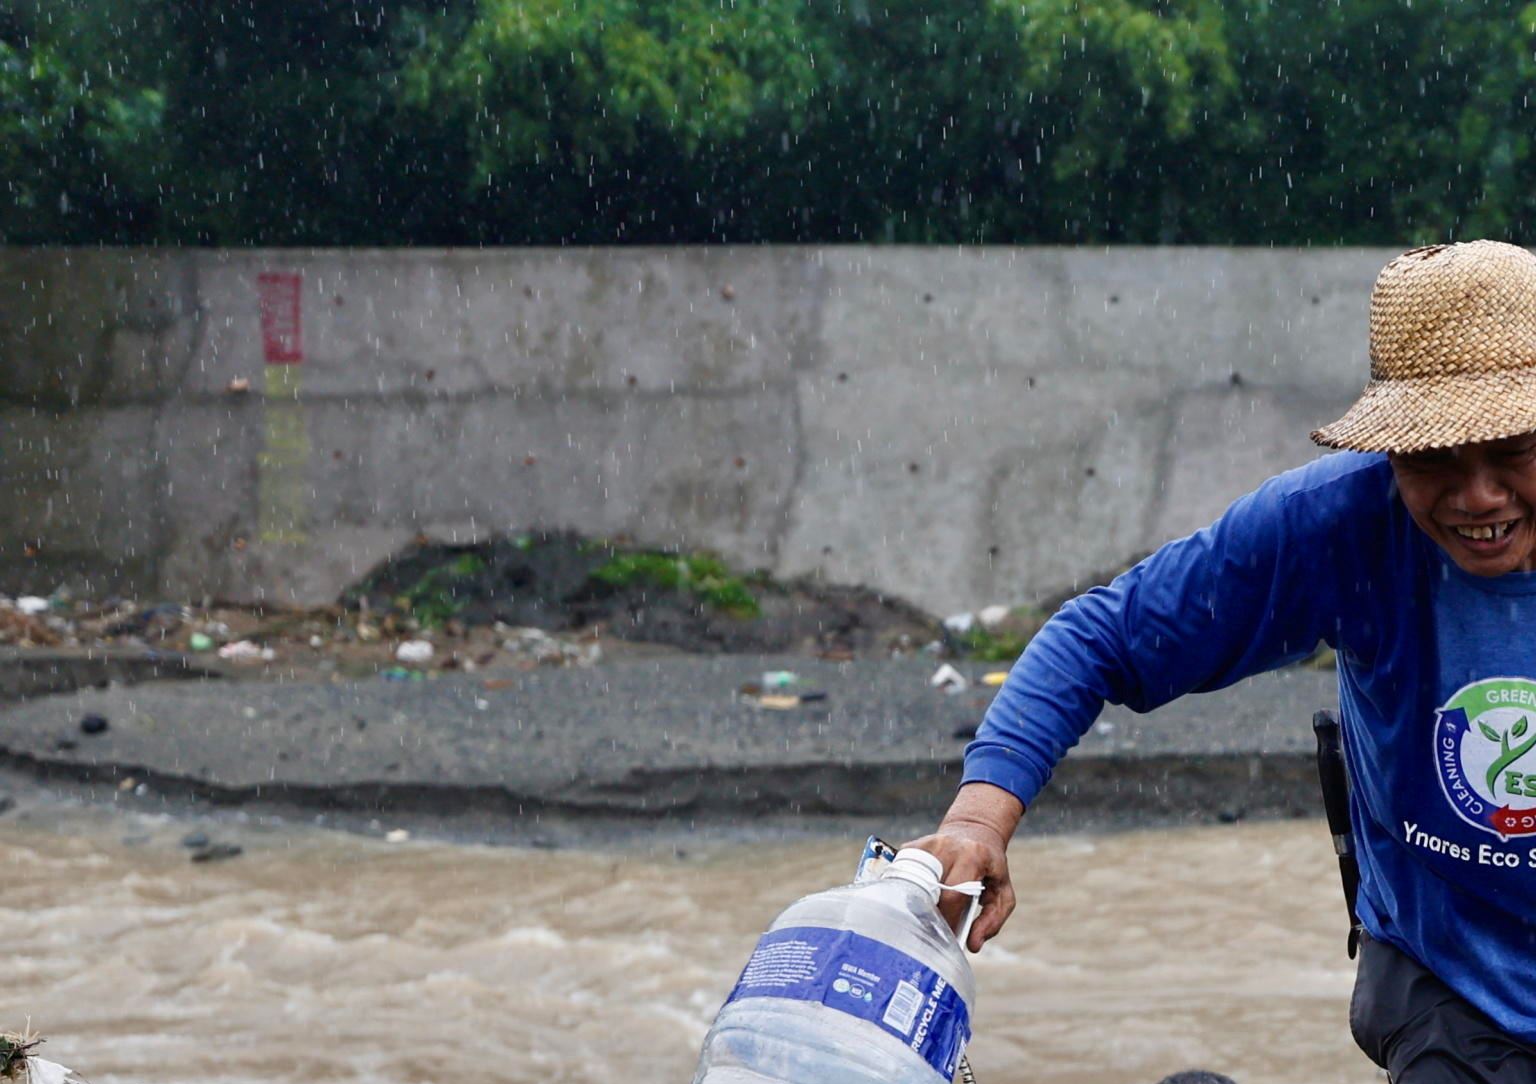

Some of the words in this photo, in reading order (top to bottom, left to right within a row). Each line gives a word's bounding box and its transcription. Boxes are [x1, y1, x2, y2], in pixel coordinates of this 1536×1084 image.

[1442, 736, 1484, 815] CLEANING
[1402, 820, 1471, 862] Ynares
[1478, 844, 1520, 868] Eco
[911, 997, 938, 1052] RECYCLE
[932, 976, 947, 1000] ME
